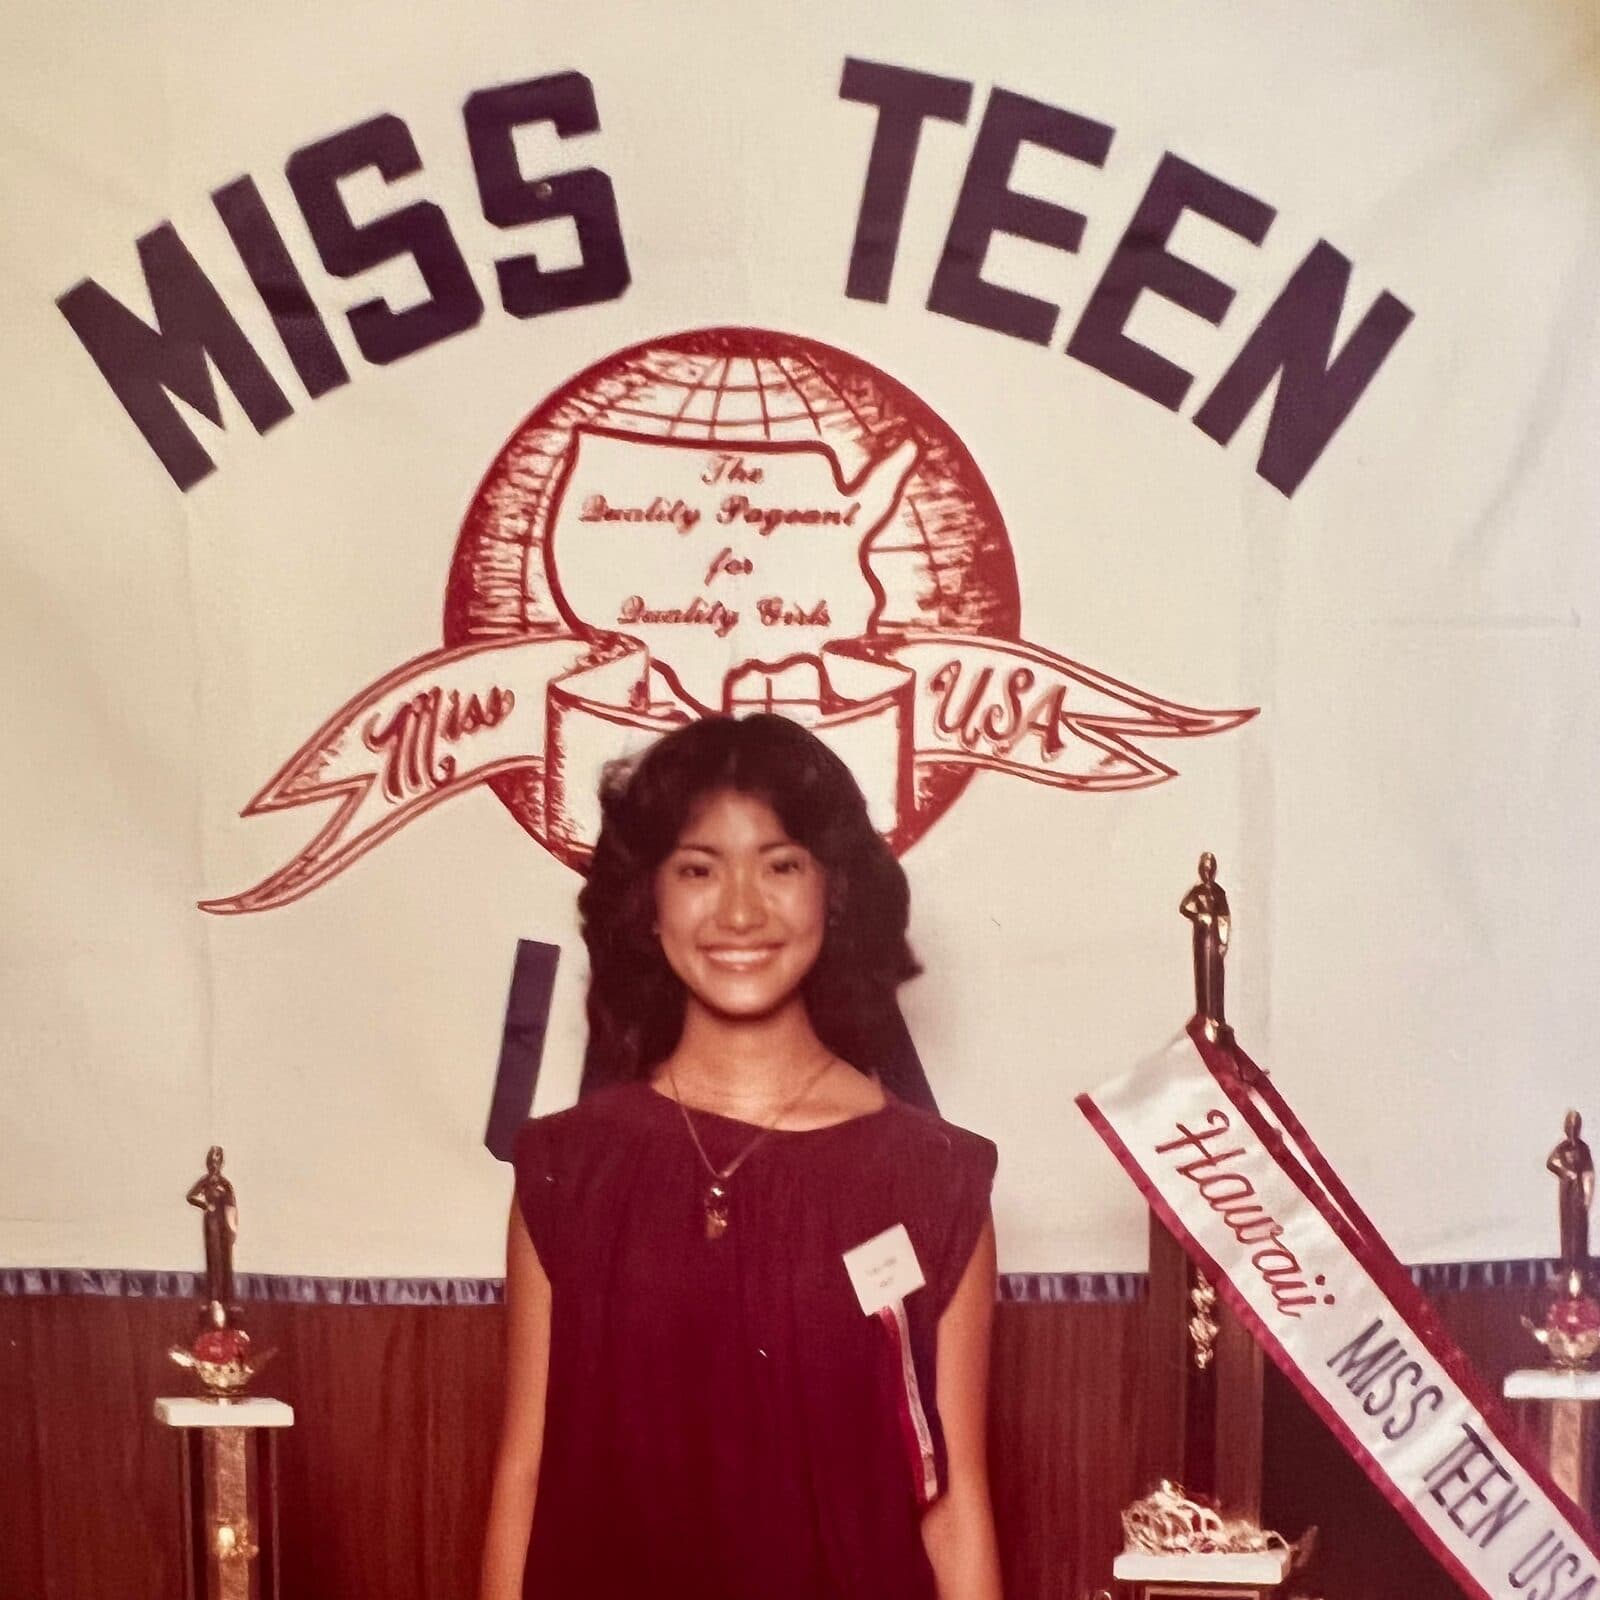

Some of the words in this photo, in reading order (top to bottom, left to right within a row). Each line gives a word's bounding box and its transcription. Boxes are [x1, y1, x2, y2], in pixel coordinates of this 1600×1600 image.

[55, 70, 632, 492] MISS
[839, 56, 1416, 499] TEEN
[702, 454, 764, 485] The
[716, 495, 861, 536] Pageant
[704, 547, 754, 586] for
[362, 685, 516, 803] Miss
[930, 659, 1067, 762] USA
[1154, 1108, 1336, 1318] Hawaii
[1326, 1318, 1445, 1442] MISS
[1422, 1422, 1531, 1549] TEEN
